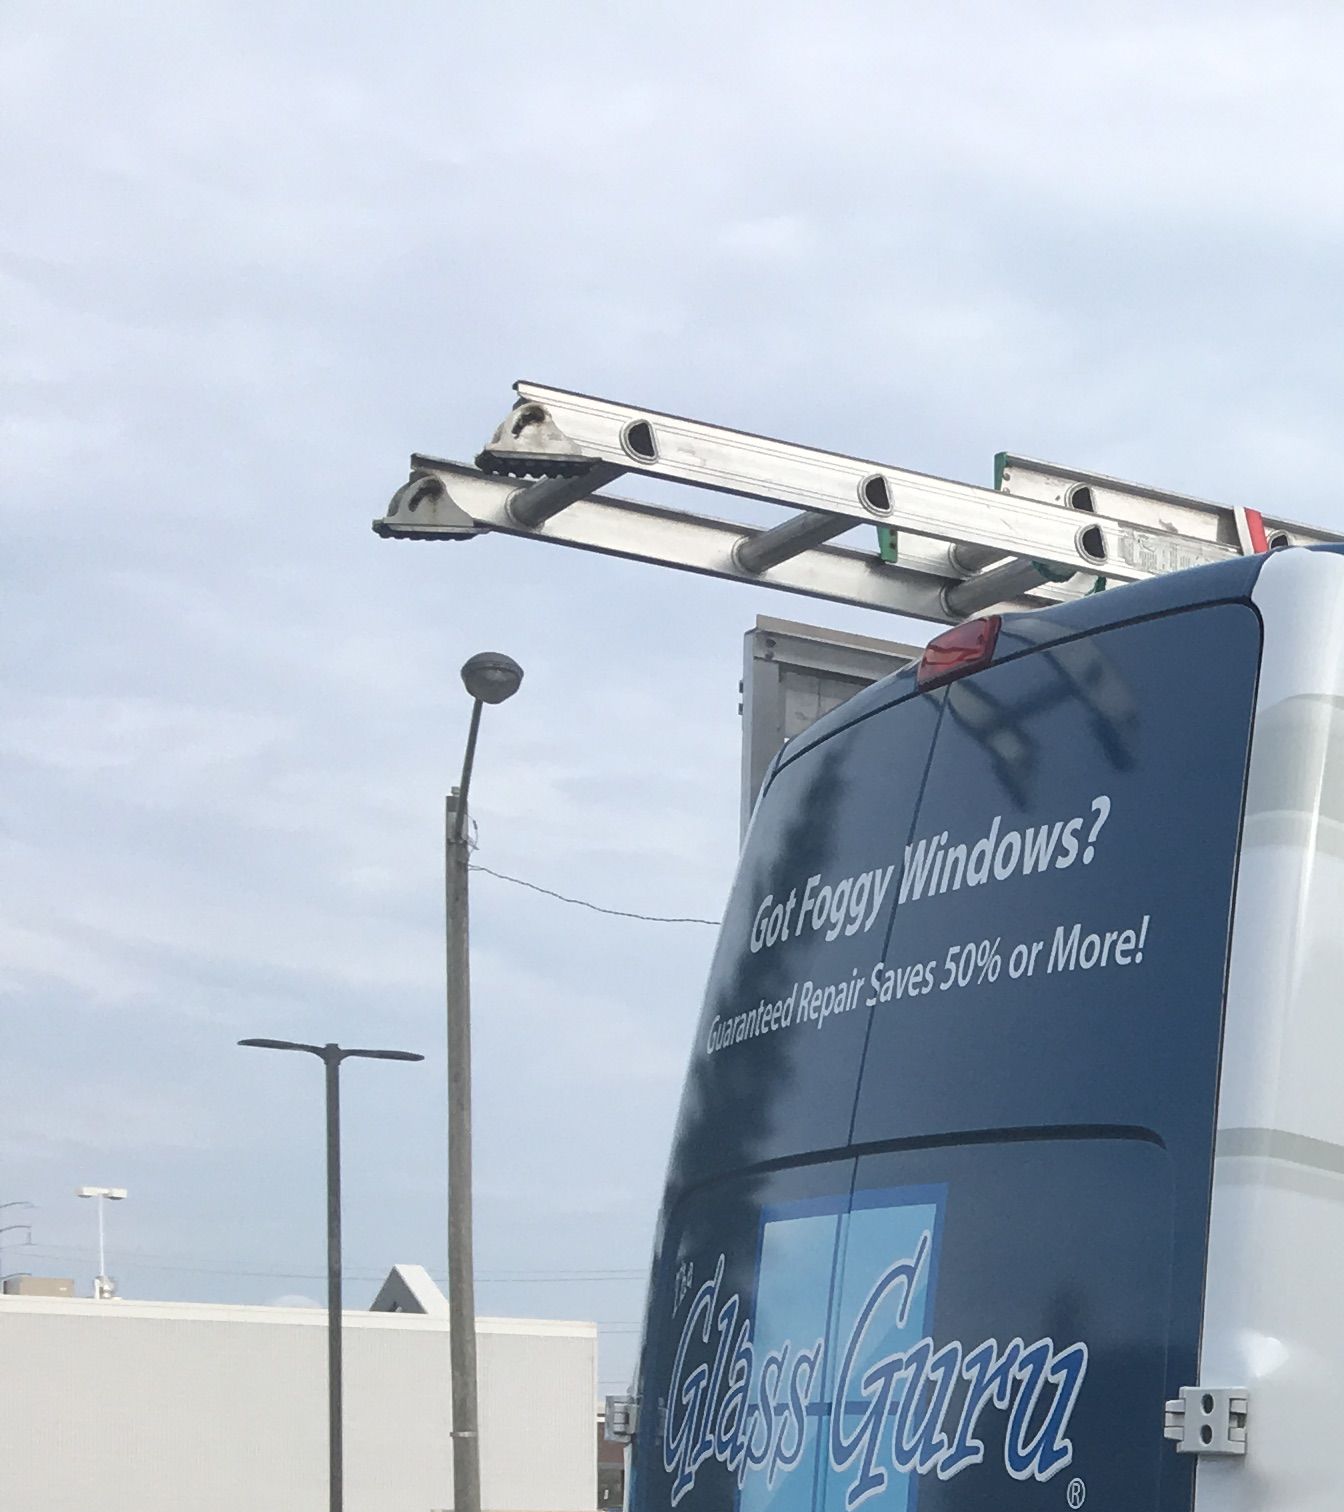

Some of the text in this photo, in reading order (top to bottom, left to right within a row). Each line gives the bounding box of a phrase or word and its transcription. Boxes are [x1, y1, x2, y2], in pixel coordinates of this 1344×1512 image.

[750, 796, 1111, 953] Got Foggy Windows?
[706, 915, 1150, 1055] Guaranteed Repair Saves 50% or More!
[663, 1253, 825, 1507] Glass
[829, 1230, 1089, 1511] Guru
